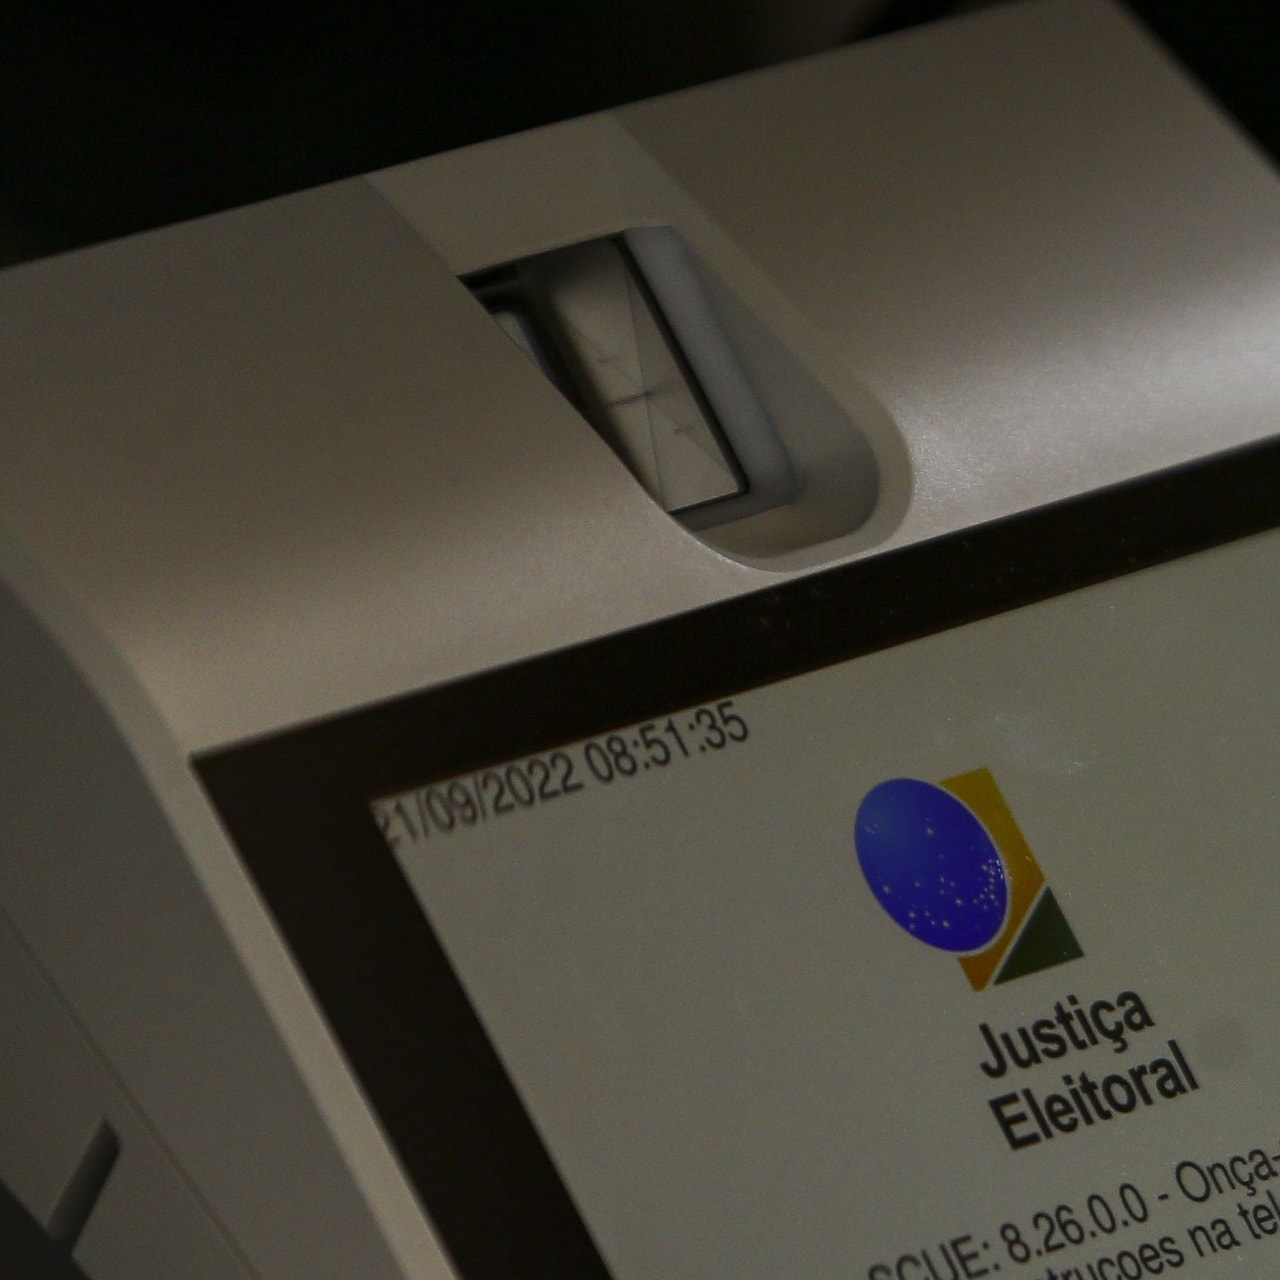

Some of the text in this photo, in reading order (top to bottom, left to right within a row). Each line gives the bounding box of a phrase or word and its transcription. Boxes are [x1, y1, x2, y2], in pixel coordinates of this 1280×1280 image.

[584, 701, 750, 784] 08:51:35
[978, 990, 1155, 1079] Justiça
[988, 1039, 1200, 1150] Eleitoral
[1000, 1182, 1149, 1264] 8.26.0.0
[1187, 1217, 1242, 1258] na
